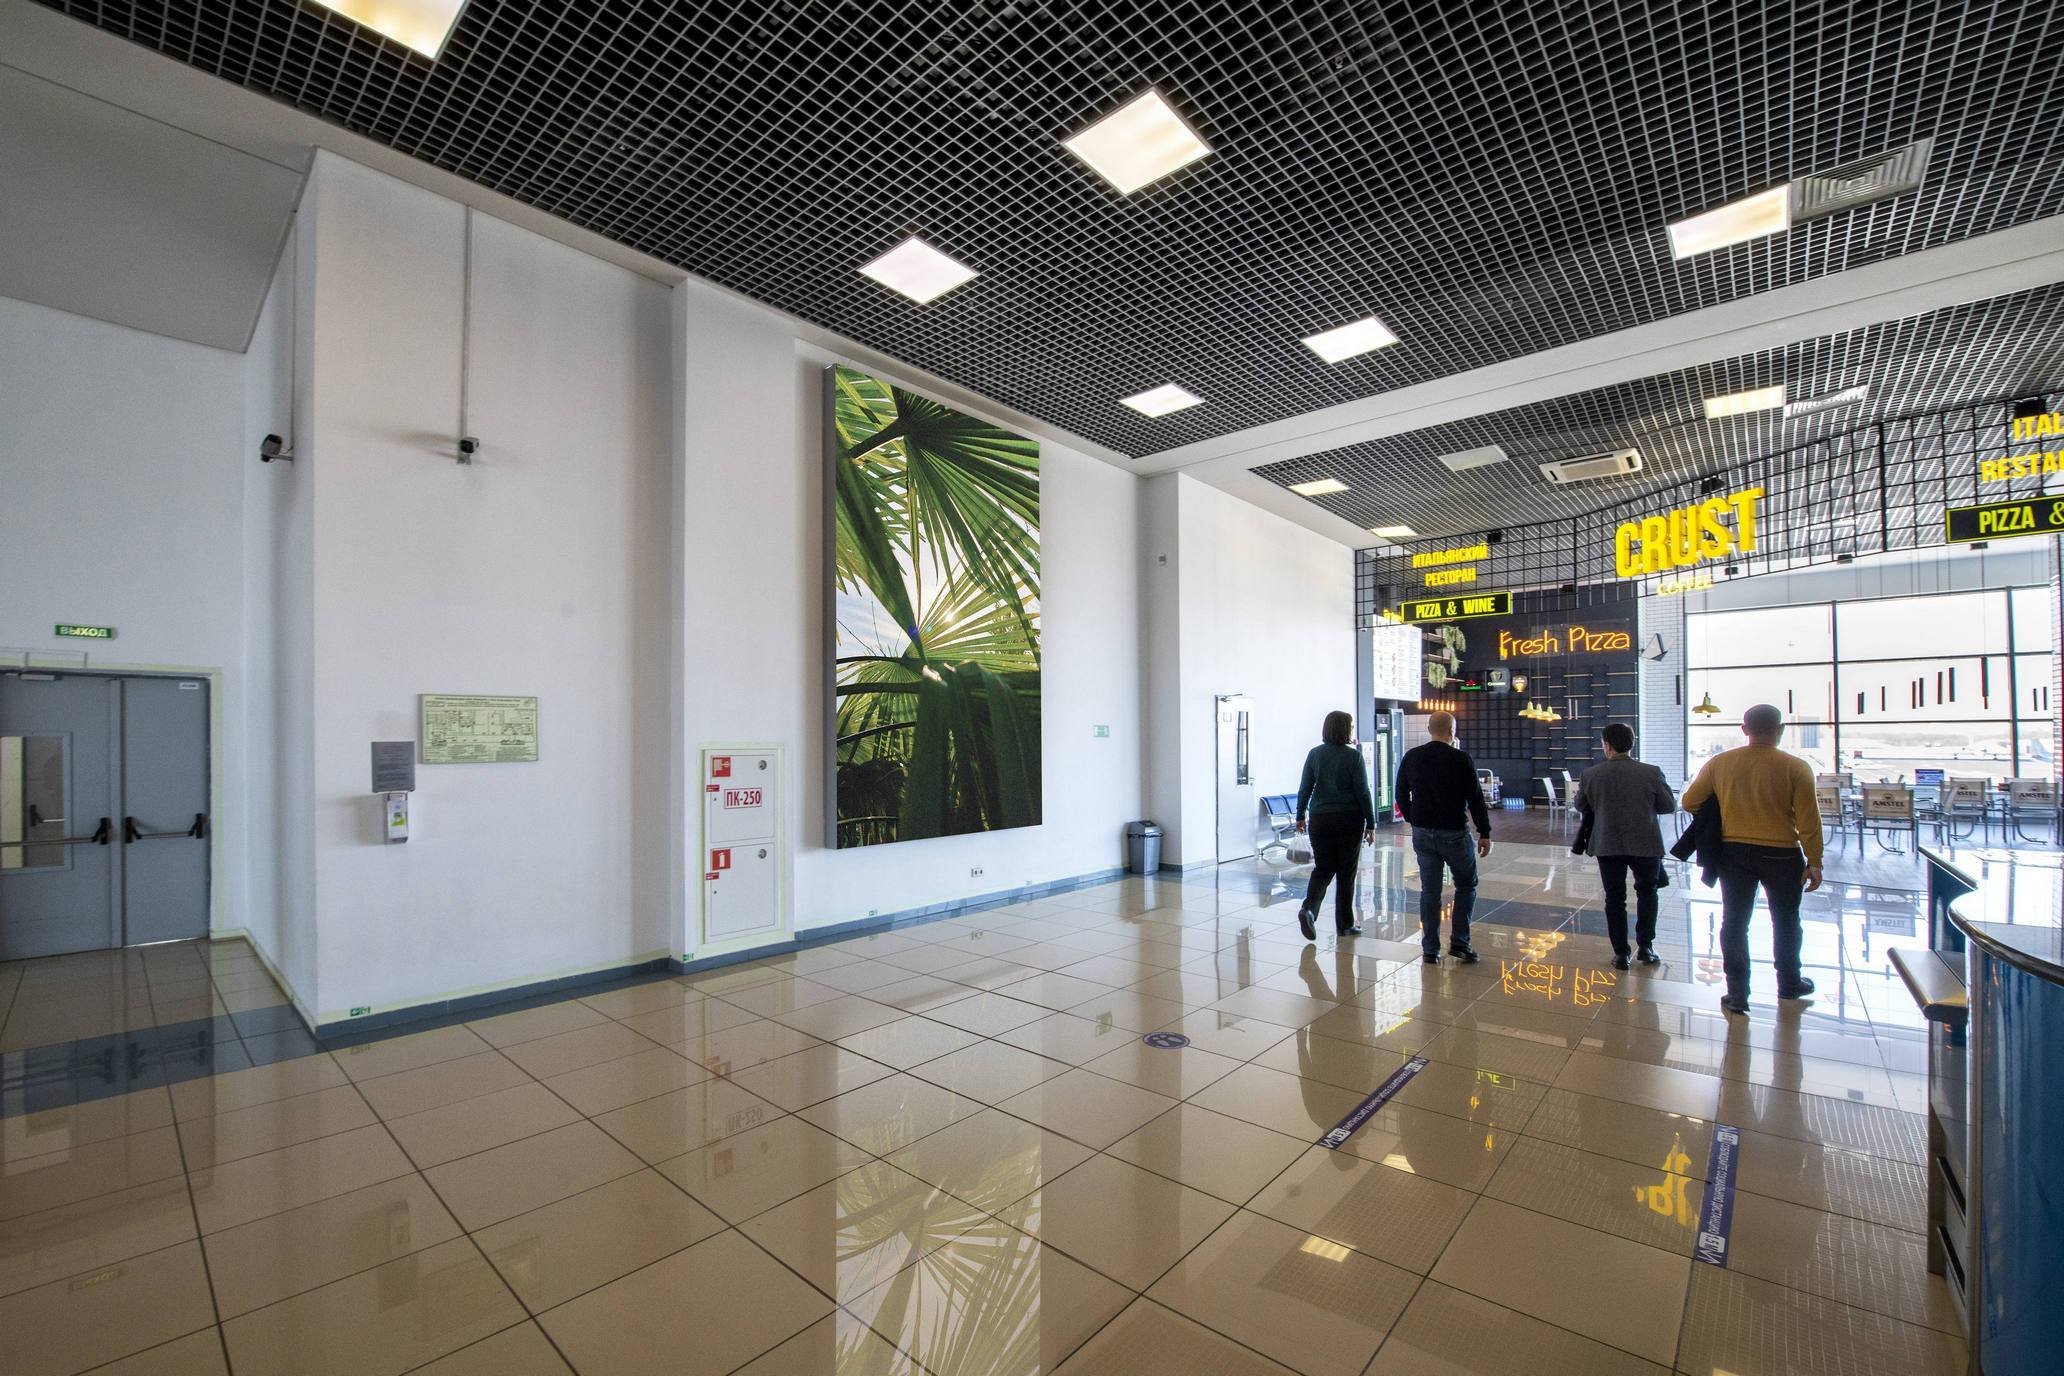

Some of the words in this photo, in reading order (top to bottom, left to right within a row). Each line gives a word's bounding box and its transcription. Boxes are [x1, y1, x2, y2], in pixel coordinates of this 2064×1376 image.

[1979, 506, 2035, 533] PIZZA
[2049, 501, 2064, 525] &
[1616, 487, 1765, 577] CRUST
[1412, 542, 1489, 568] ИТАЛЬЯНСКИЙ
[1425, 567, 1477, 587] РЕСТОРАН
[1416, 603, 1441, 619] PIZZA
[1446, 601, 1457, 615] &
[1463, 597, 1495, 614] WINE
[59, 626, 108, 637] ВЫХОД
[1500, 629, 1558, 657] Fresh
[1569, 627, 1631, 652] Pizza
[726, 791, 761, 807] ПК-250
